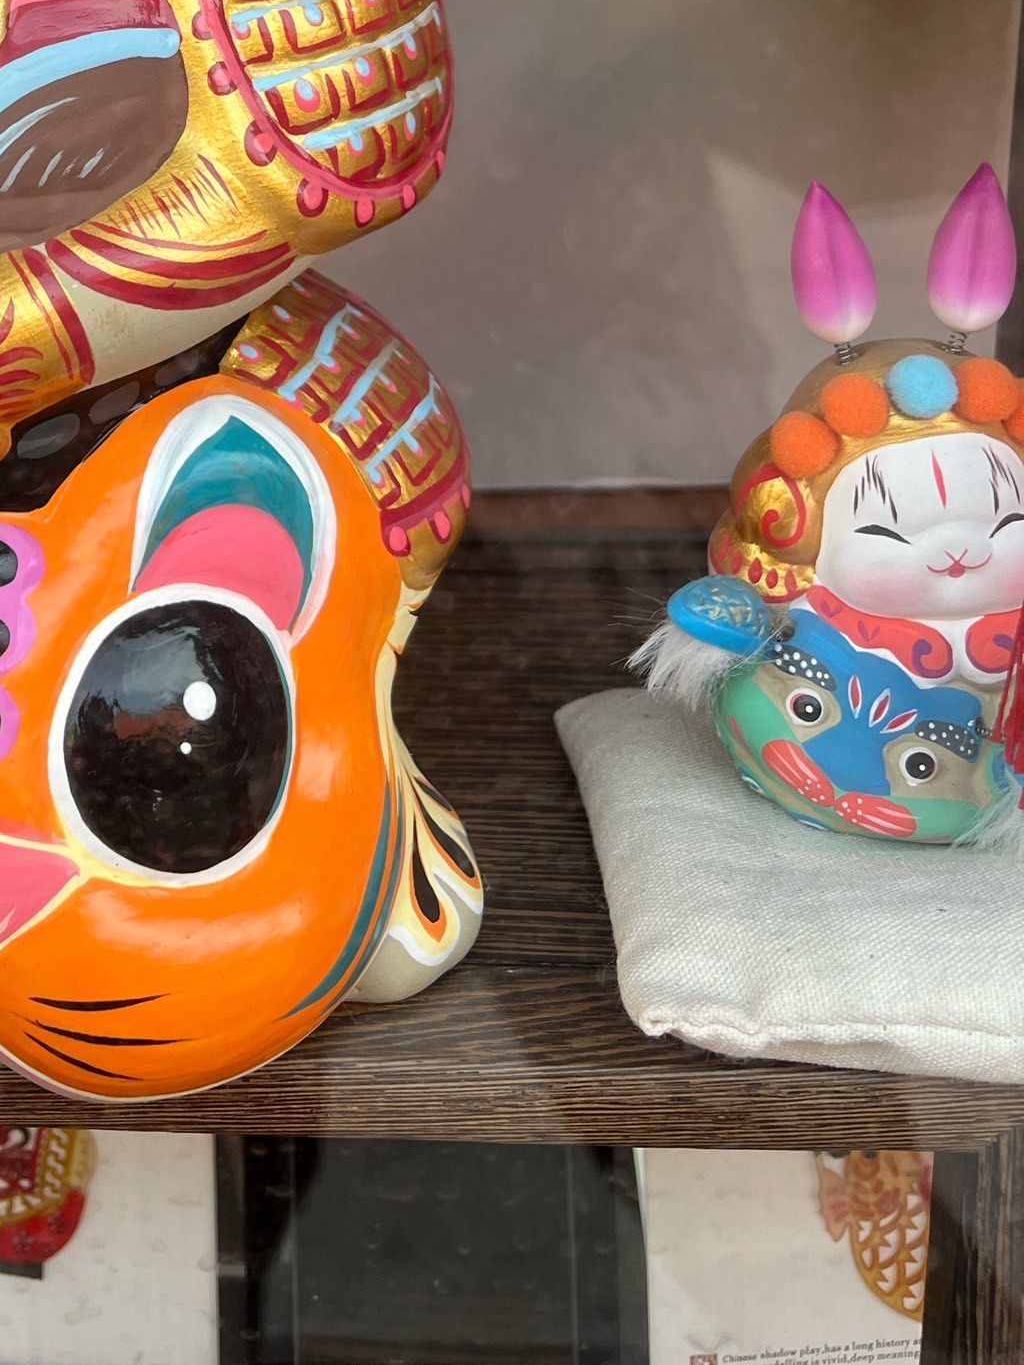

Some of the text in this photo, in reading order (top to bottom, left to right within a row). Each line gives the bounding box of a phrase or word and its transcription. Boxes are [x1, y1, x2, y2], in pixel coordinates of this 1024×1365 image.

[760, 1348, 797, 1359] shadow
[852, 1341, 874, 1351] long
[876, 1339, 910, 1348] history
